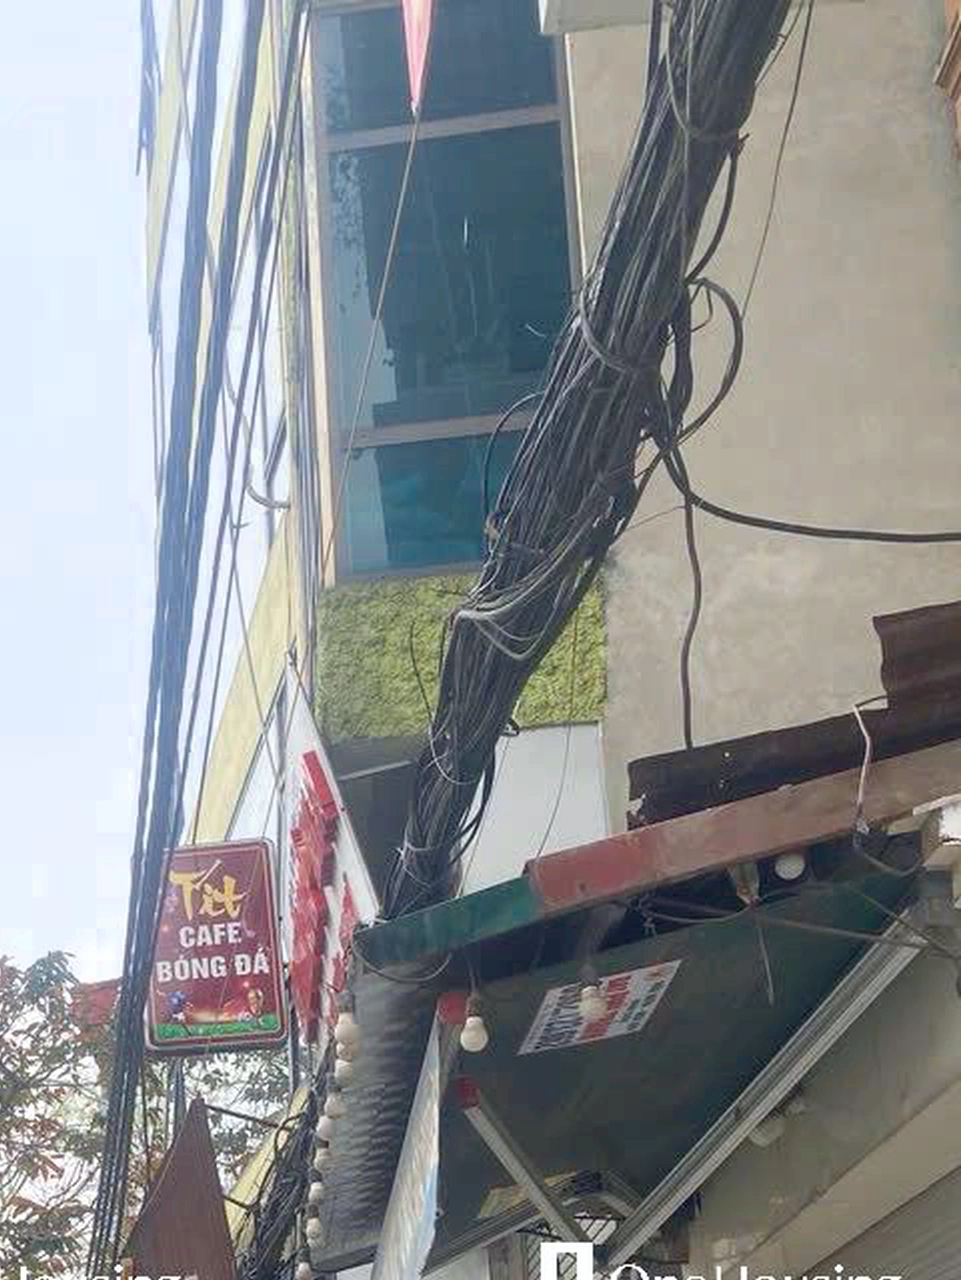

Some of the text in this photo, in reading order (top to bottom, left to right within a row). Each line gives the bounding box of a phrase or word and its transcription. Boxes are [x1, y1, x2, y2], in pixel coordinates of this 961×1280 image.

[179, 922, 242, 948] CAFE
[156, 946, 270, 982] BÓNG ĐÁ
